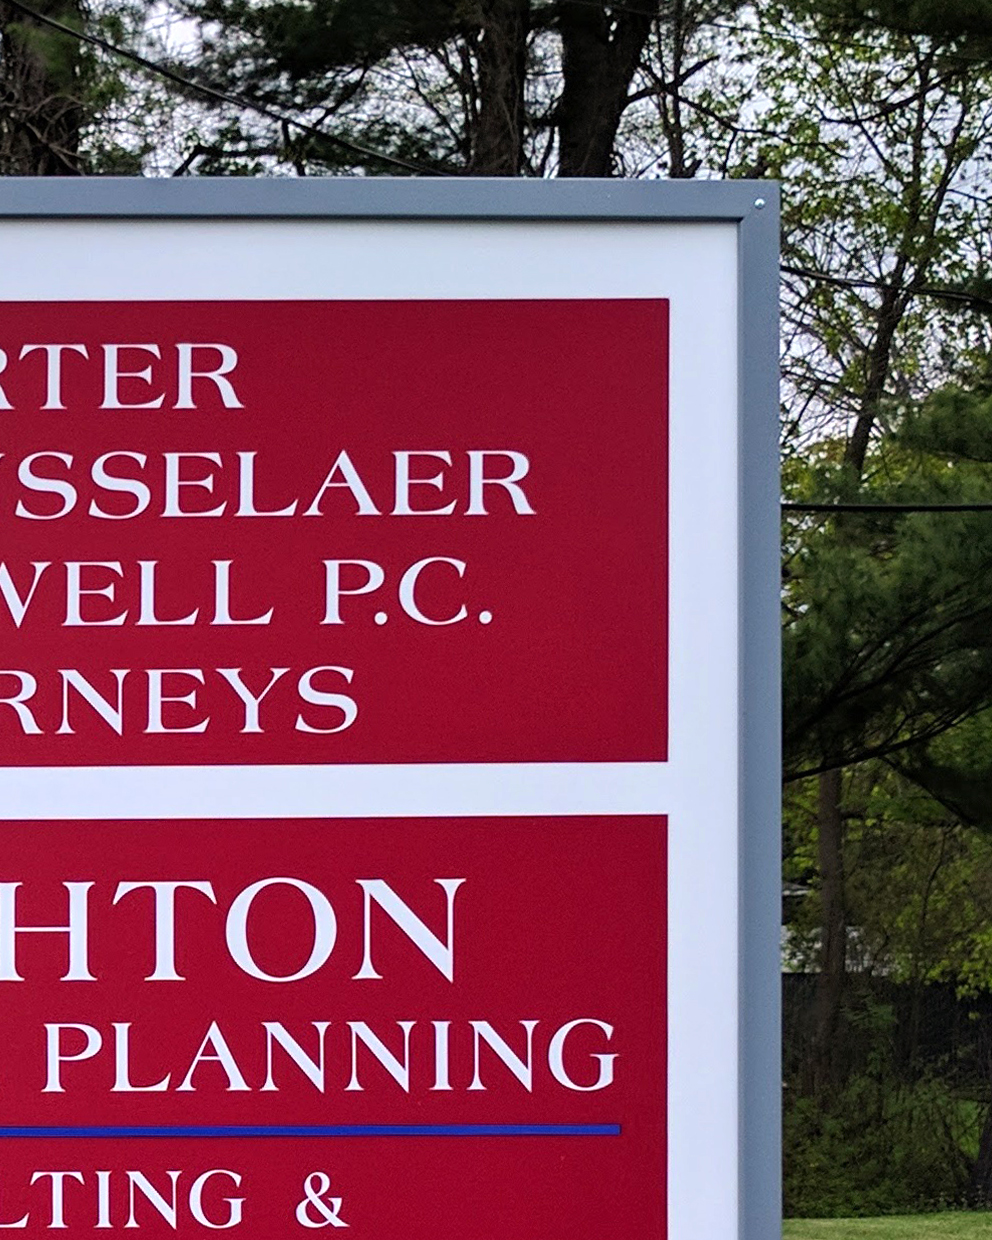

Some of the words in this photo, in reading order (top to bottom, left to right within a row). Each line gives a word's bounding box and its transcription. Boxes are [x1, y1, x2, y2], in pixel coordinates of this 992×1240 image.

[320, 556, 493, 626] P.C.
[41, 1018, 619, 1093] PLANNING
[295, 1171, 349, 1228] &
